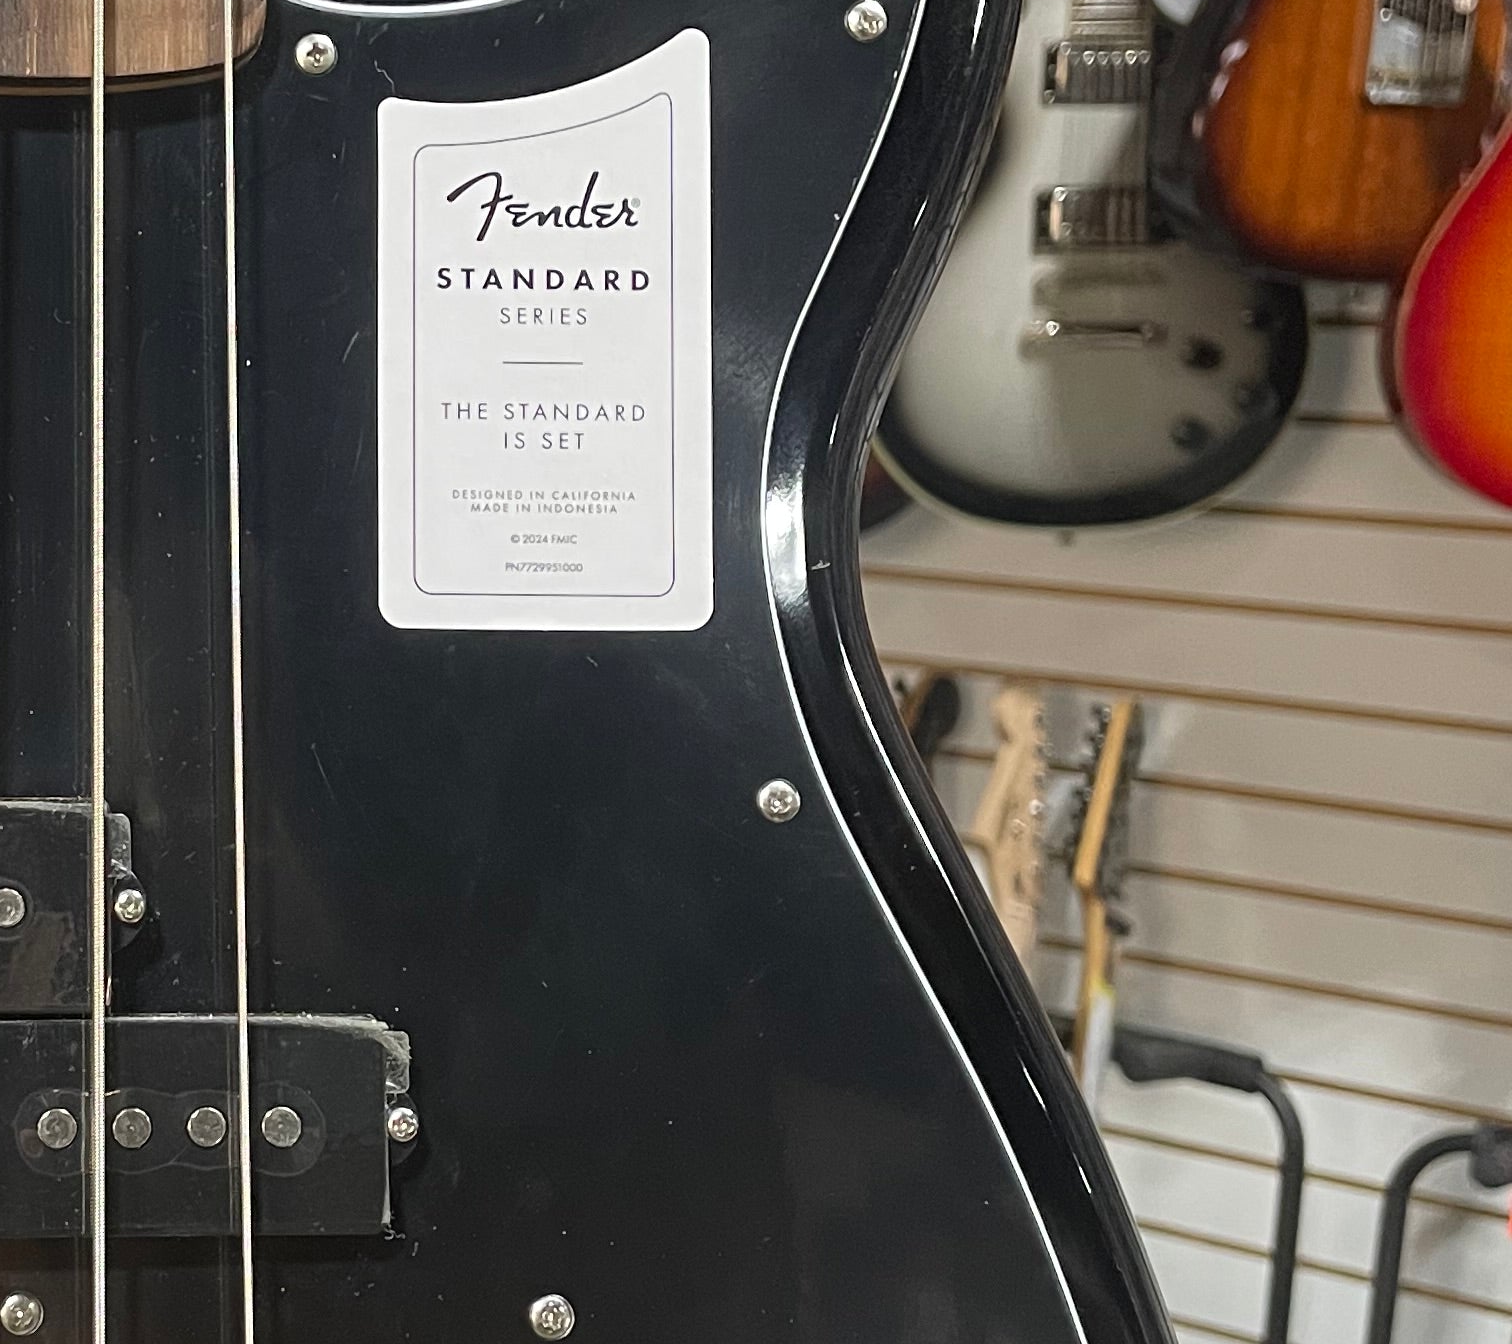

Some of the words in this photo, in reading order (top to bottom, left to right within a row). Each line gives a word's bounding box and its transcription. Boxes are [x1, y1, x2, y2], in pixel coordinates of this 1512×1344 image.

[446, 171, 639, 242] Fender
[436, 267, 651, 292] STANDARD
[499, 307, 588, 325] SERIES
[441, 402, 489, 420] THE
[503, 403, 646, 422] STANDARD
[503, 431, 526, 450] IS
[541, 432, 585, 450] SET
[451, 489, 524, 501] DESIGNED
[529, 490, 546, 501] IN
[551, 490, 637, 502] CALIFORNIA
[469, 503, 510, 514] MADE
[515, 503, 532, 514] IN
[537, 503, 619, 515] INDONESIA
[522, 534, 549, 545] 2024
